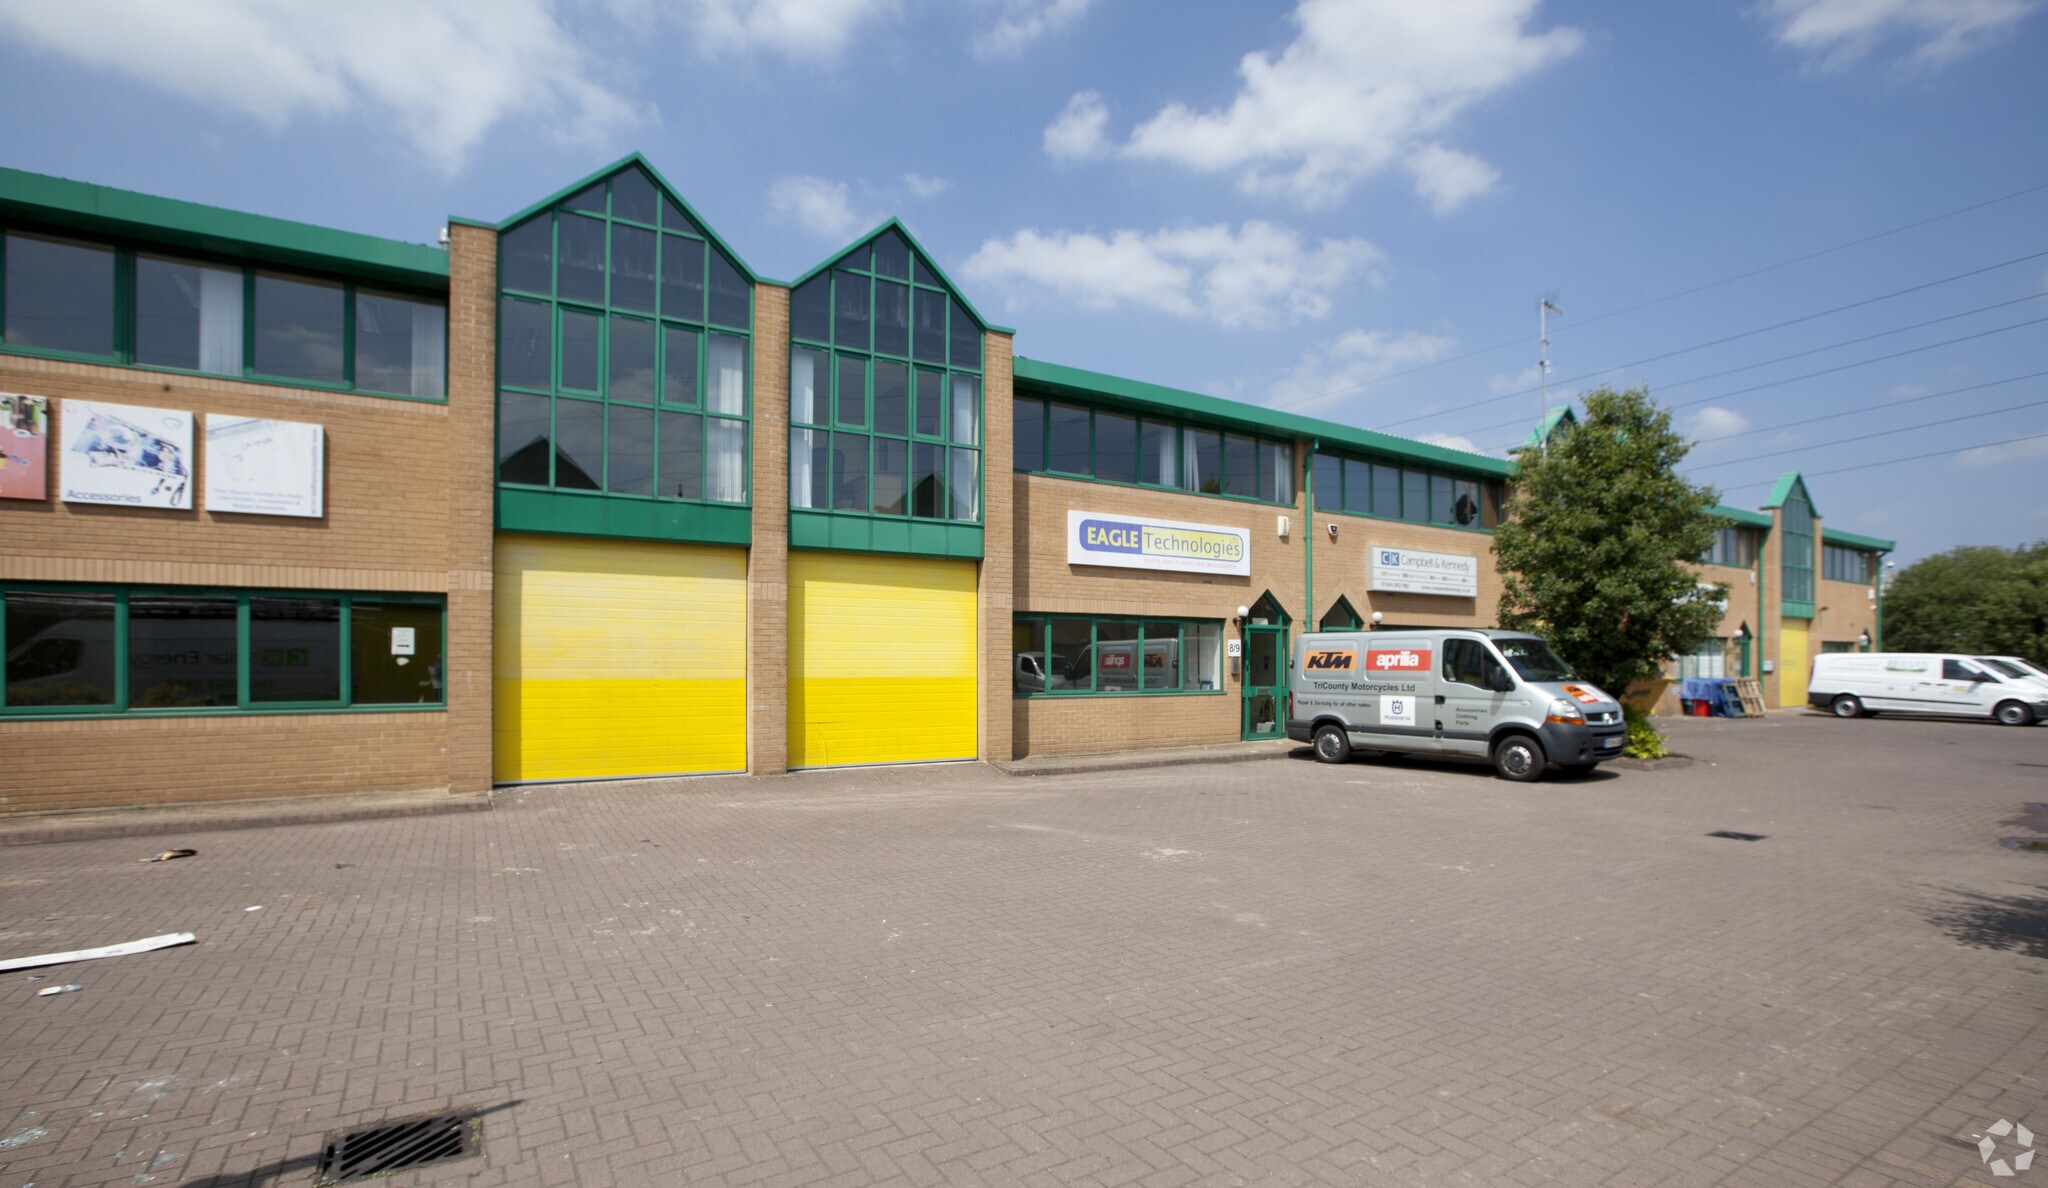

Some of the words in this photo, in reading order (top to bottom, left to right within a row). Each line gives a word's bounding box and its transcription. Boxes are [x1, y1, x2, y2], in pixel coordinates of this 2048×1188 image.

[67, 489, 142, 503] Accessories
[1087, 527, 1139, 549] EAGLE
[1143, 532, 1240, 558] Technologies
[1381, 551, 1400, 566] CK
[1401, 554, 1434, 569] Campbell
[1442, 559, 1471, 574] Kennedy
[1229, 644, 1240, 654] 8/9
[1307, 651, 1352, 669] KTM
[1376, 650, 1419, 670] aprilia
[1314, 682, 1349, 692] TriCounty
[1351, 682, 1399, 693] Motorcycles
[1402, 684, 1415, 692] Ltd
